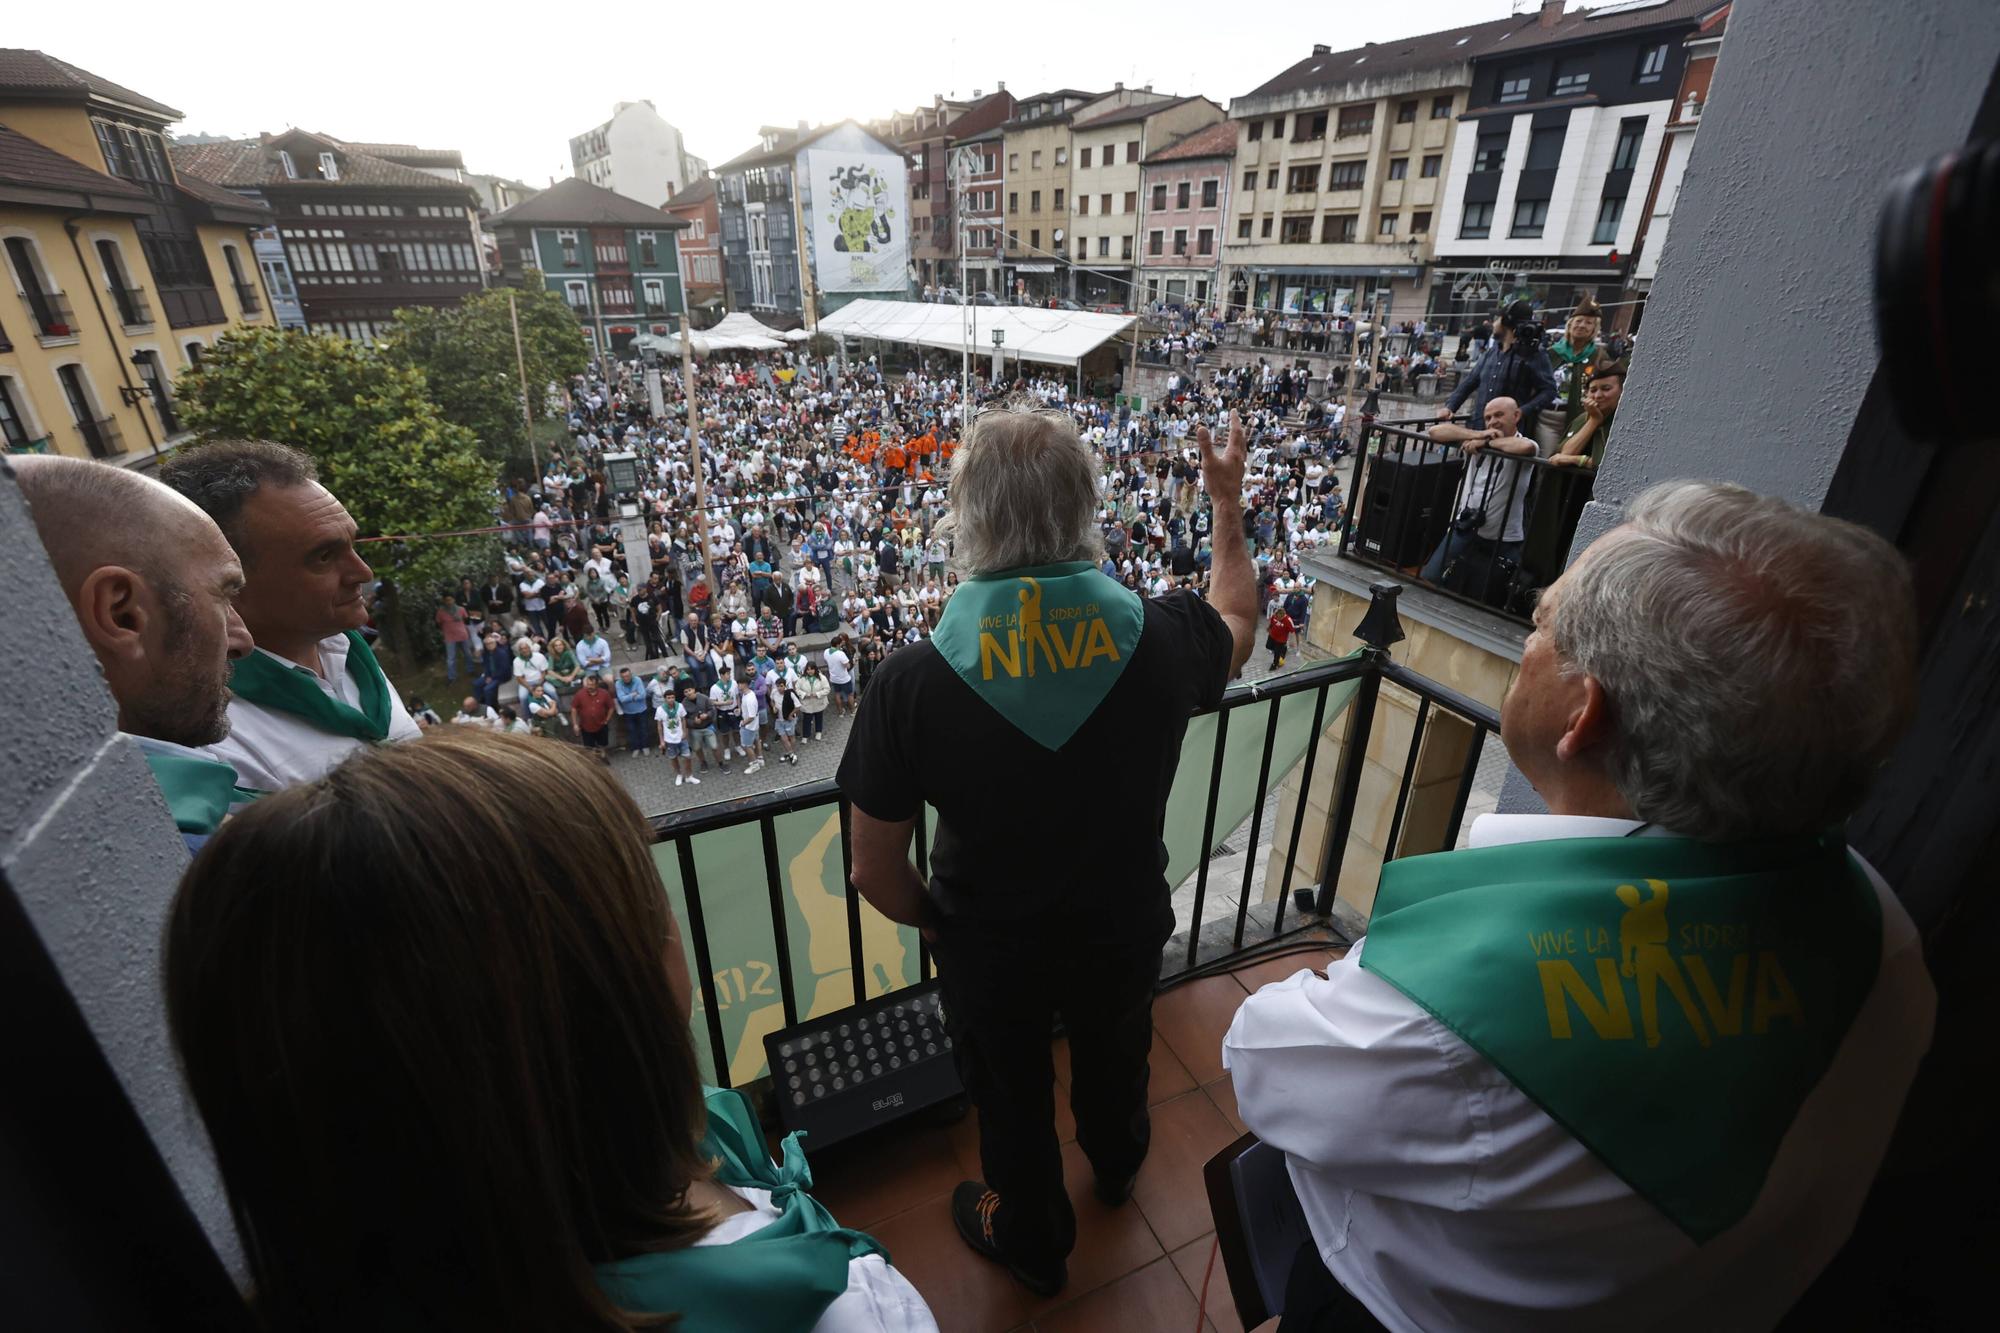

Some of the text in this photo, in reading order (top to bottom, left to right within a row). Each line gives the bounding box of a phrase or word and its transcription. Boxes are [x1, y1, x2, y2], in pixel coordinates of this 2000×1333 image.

[979, 603, 1099, 629] VIVE LA SIDRA EN
[1527, 928, 1576, 957] VIVE
[1585, 927, 1610, 953] LA
